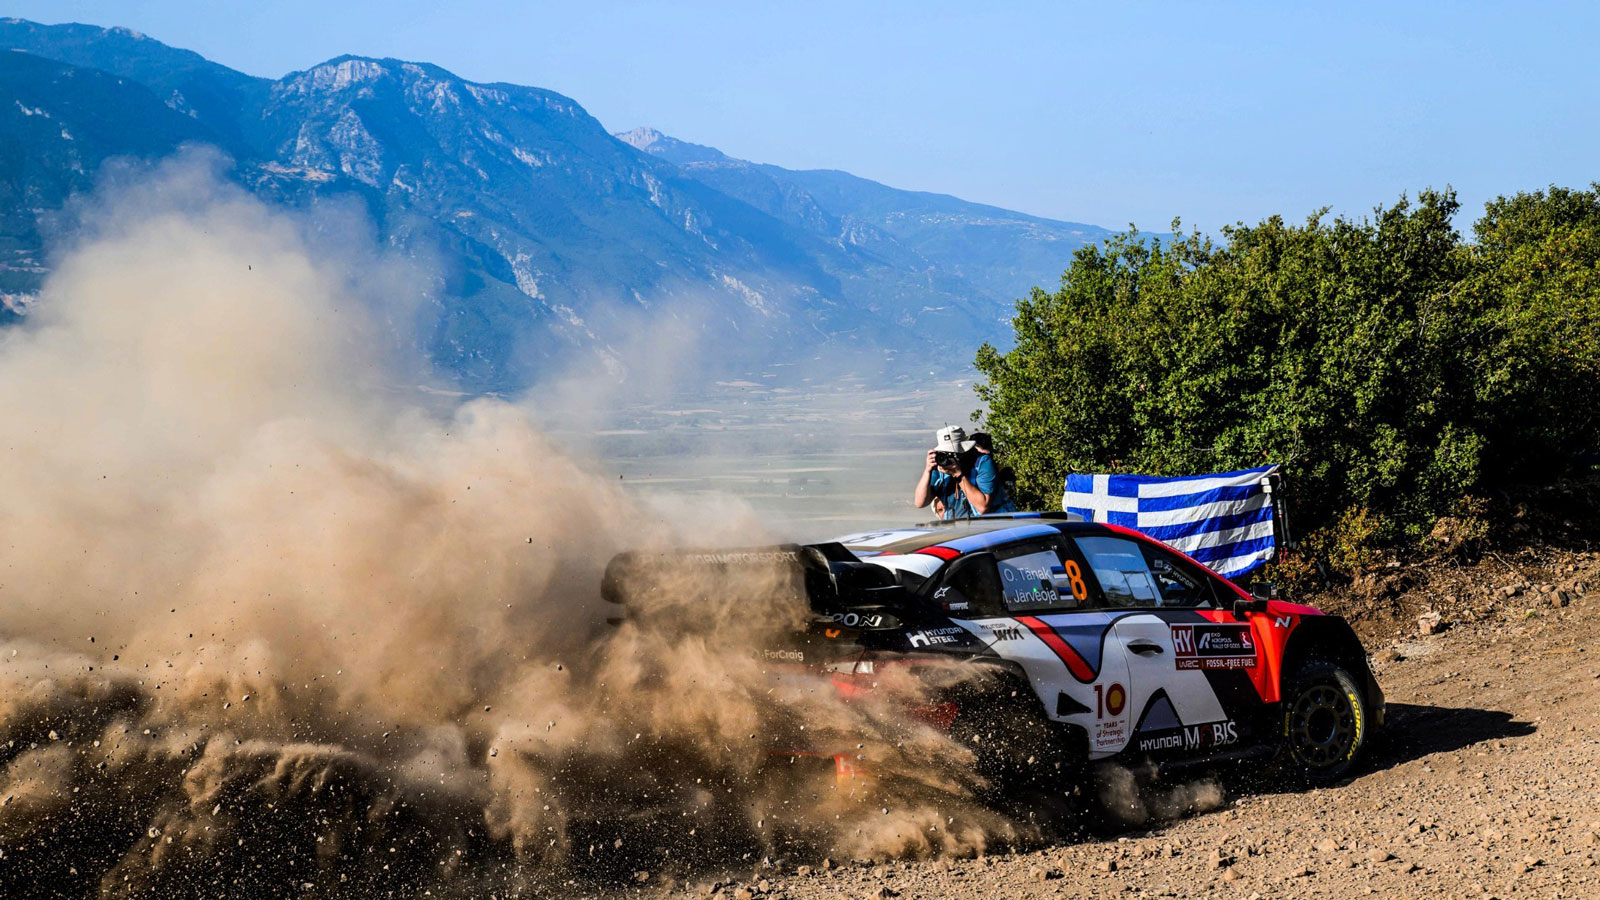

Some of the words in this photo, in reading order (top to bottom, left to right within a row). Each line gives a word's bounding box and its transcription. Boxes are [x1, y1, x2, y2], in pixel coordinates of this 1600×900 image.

[1003, 568, 1018, 582] O.
[1018, 566, 1052, 581] Tänak
[1064, 559, 1088, 601] 8
[1172, 570, 1195, 589] HYUNDAI
[1014, 587, 1057, 605] Järveoja
[1274, 616, 1291, 628] N
[924, 626, 964, 636] HYUNDAI
[929, 635, 959, 644] STEEL
[1172, 630, 1191, 653] HY
[1179, 660, 1199, 668] WRC
[1206, 659, 1240, 668] FOSSIL-FREE
[1241, 658, 1255, 667] FUEL
[1094, 683, 1126, 719] 10
[1096, 729, 1102, 738] of
[1102, 727, 1124, 738] Strategic
[1103, 721, 1118, 729] YEARS
[1347, 693, 1361, 760] SCORPION
[1096, 736, 1126, 747] Partnership
[1140, 735, 1183, 751] HYUNDAI
[1183, 721, 1238, 749] MOBIS
